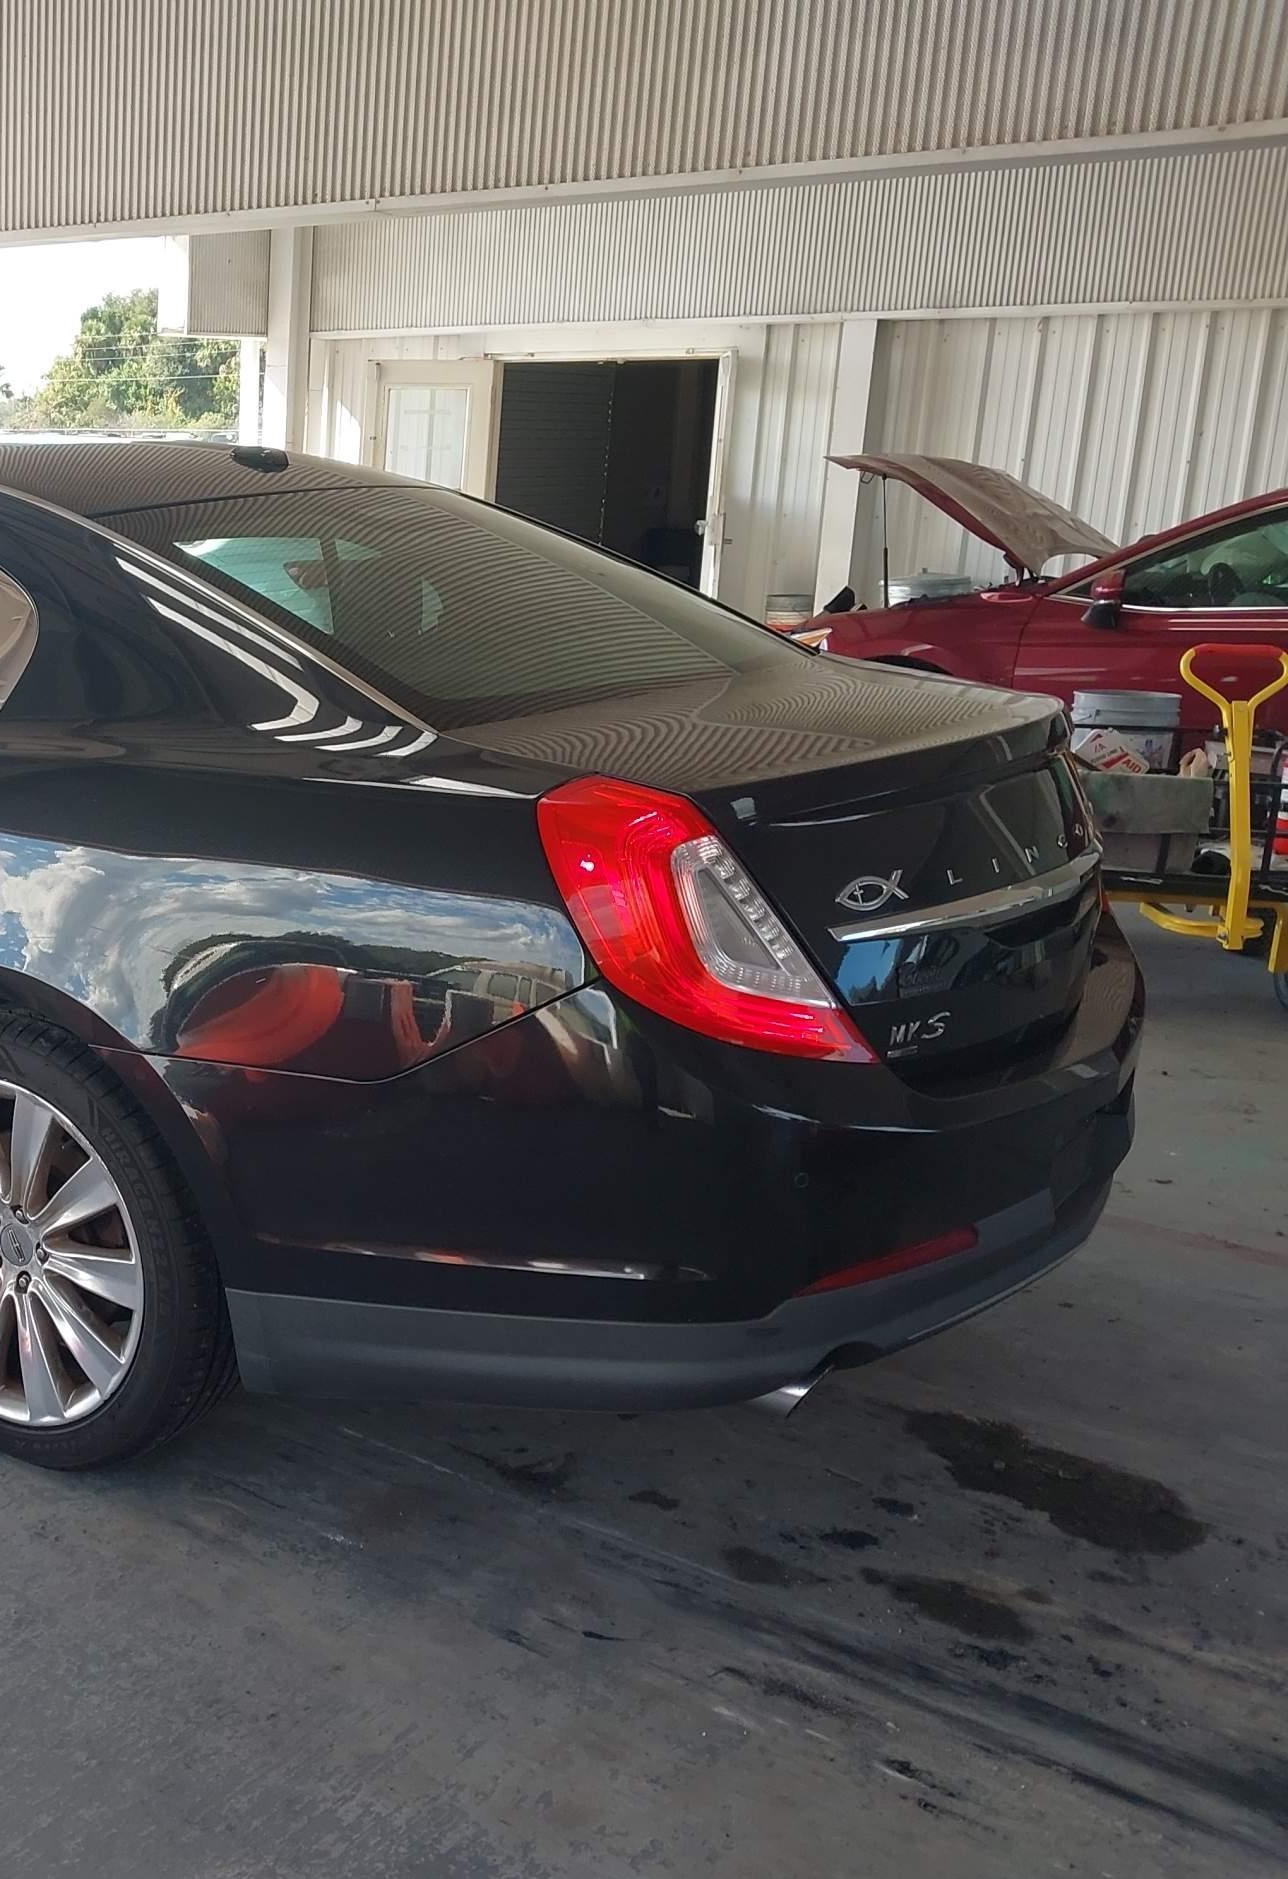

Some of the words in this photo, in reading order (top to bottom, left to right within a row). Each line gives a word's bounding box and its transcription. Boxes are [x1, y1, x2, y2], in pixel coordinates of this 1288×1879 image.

[1122, 758, 1143, 774] AID
[945, 823, 1084, 886] LINCO
[890, 1012, 951, 1046] MKS
